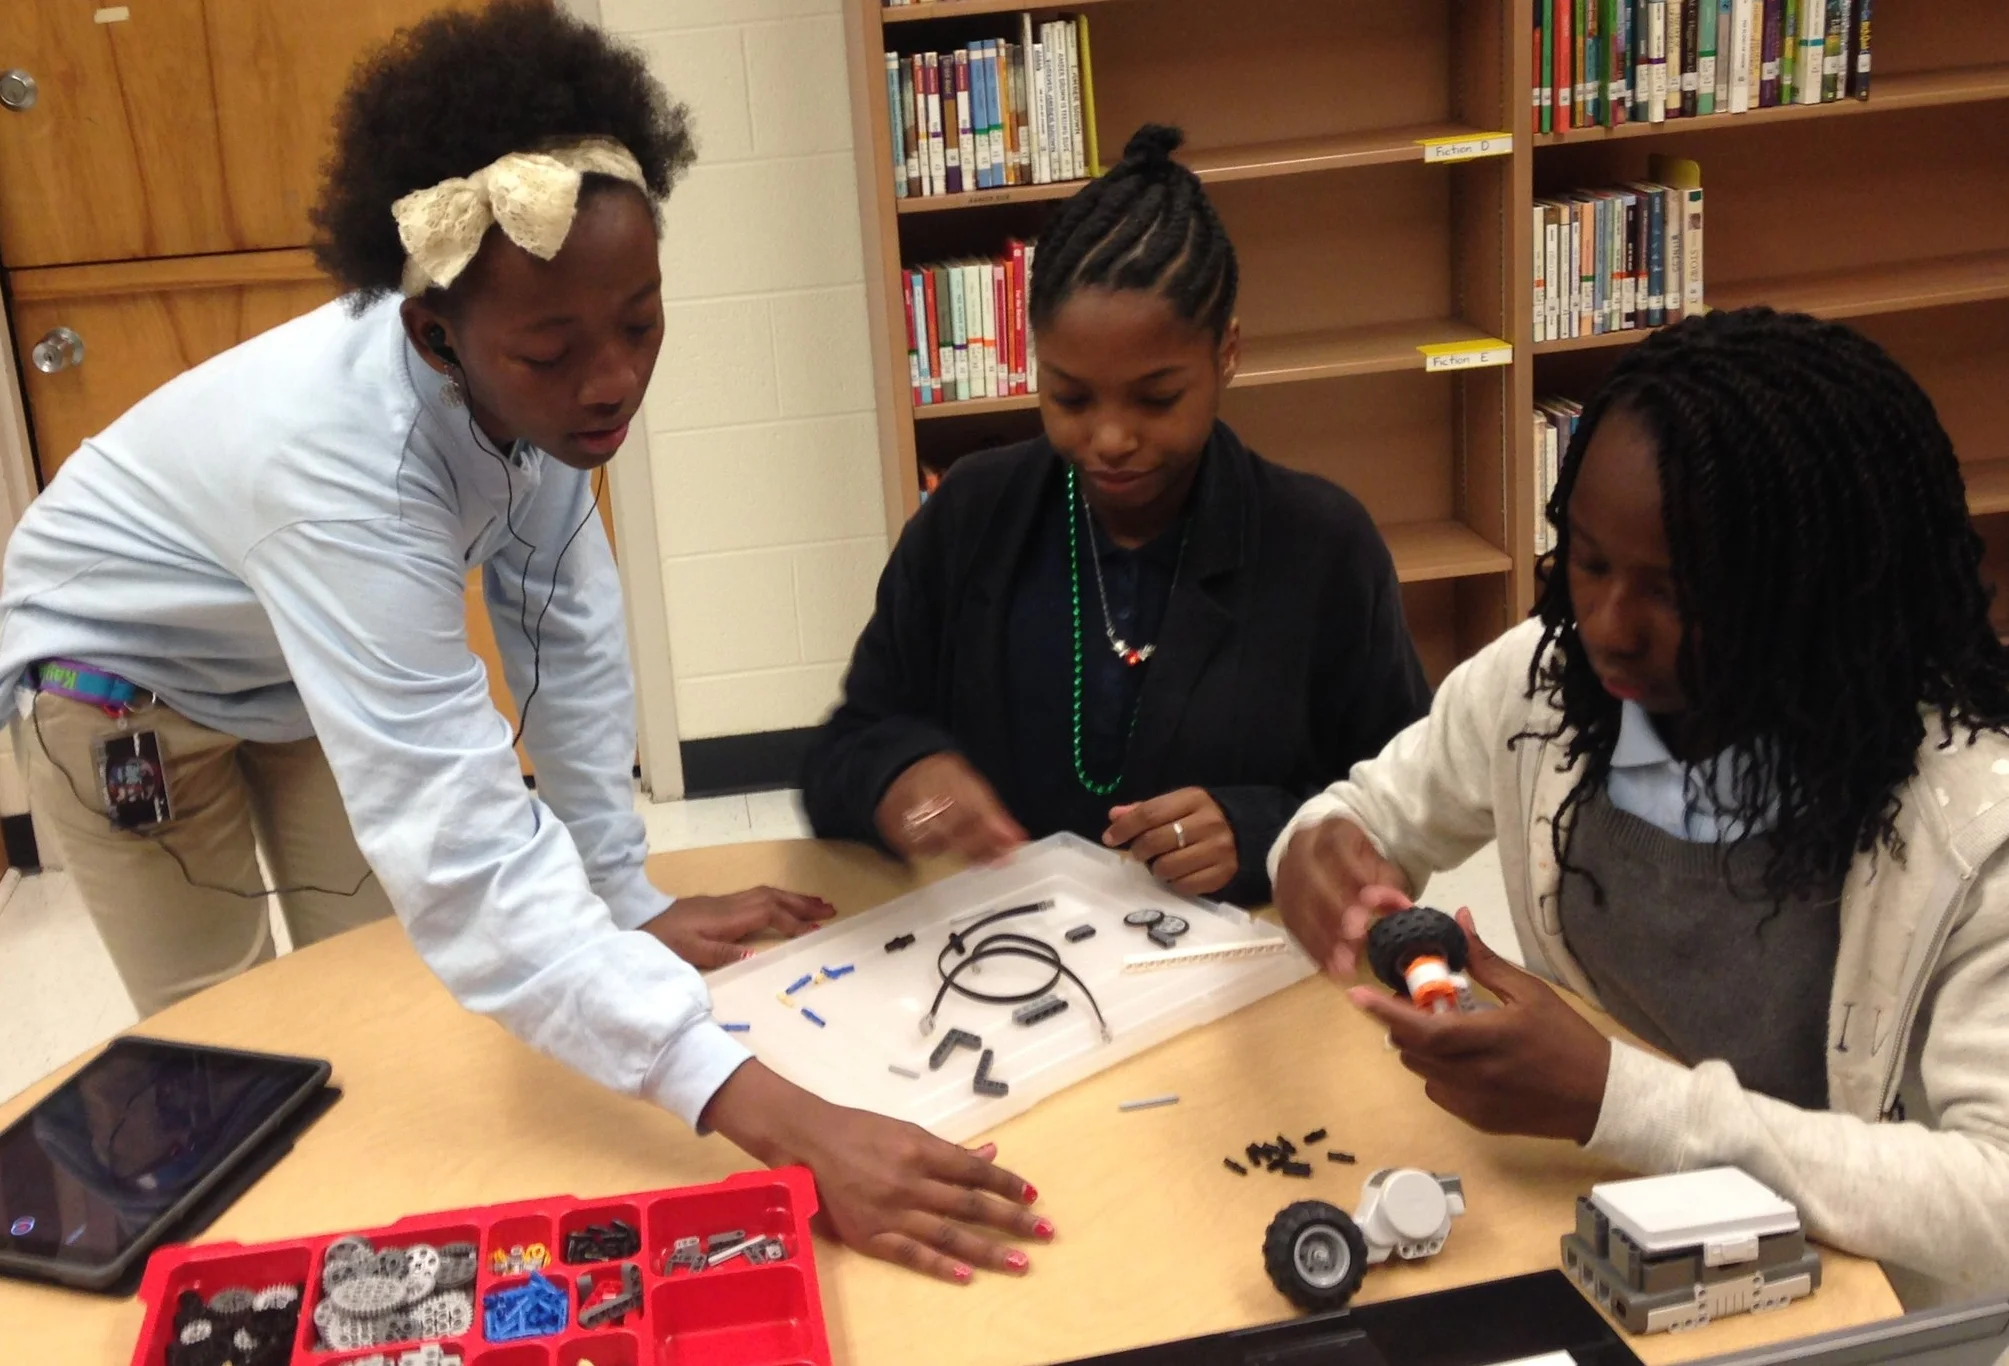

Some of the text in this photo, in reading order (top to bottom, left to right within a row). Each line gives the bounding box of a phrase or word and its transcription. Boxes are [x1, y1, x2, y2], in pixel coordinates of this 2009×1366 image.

[1435, 140, 1490, 157] Fiction D
[1432, 352, 1489, 367] Fiction E
